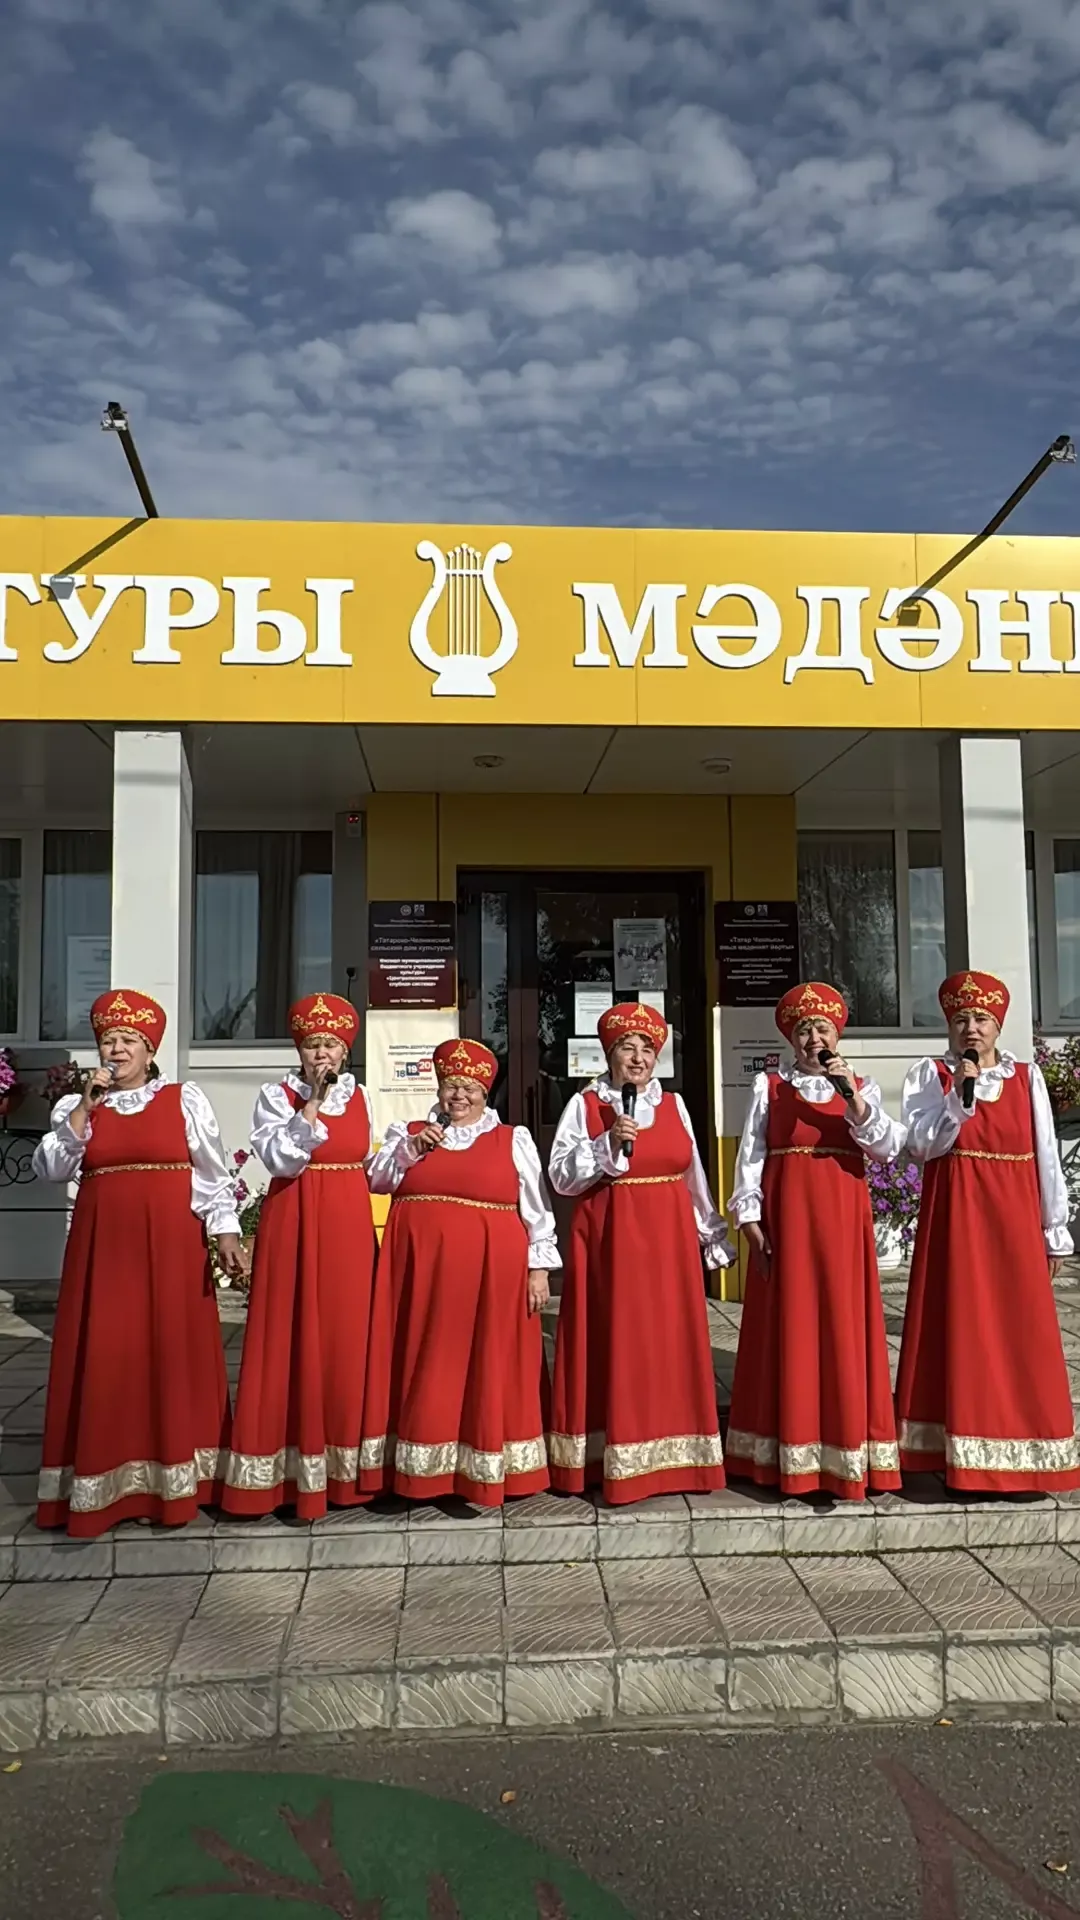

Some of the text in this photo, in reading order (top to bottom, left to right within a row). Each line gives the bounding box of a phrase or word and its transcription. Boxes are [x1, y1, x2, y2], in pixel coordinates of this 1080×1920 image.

[571, 582, 1080, 685] МӘДӘН
[407, 1065, 418, 1073] 19
[419, 1061, 431, 1069] 20
[743, 1056, 778, 1072] 18 19 20
